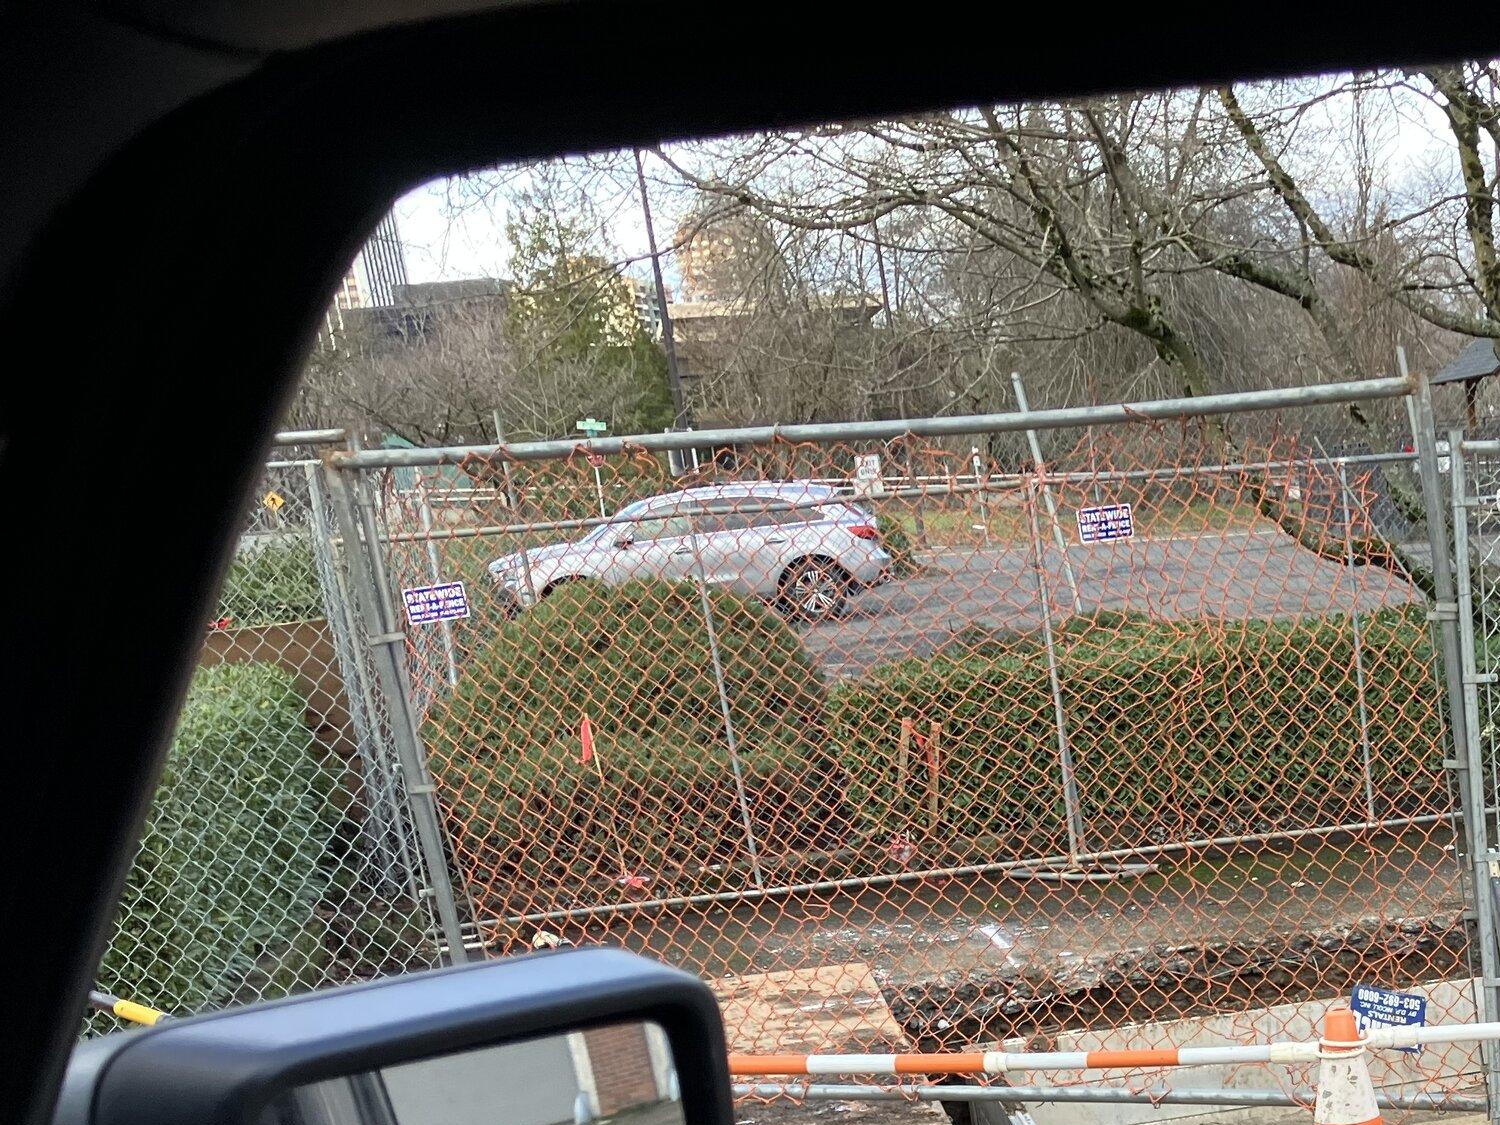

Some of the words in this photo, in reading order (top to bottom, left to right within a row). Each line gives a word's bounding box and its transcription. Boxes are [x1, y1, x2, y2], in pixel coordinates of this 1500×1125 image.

[1079, 508, 1129, 524] STATEWIDE
[406, 585, 463, 604] STATEWIDE
[1357, 988, 1421, 1011] 503-692-6080
[1368, 1010, 1407, 1024] RENTALS
[1407, 1010, 1417, 1018] BY
